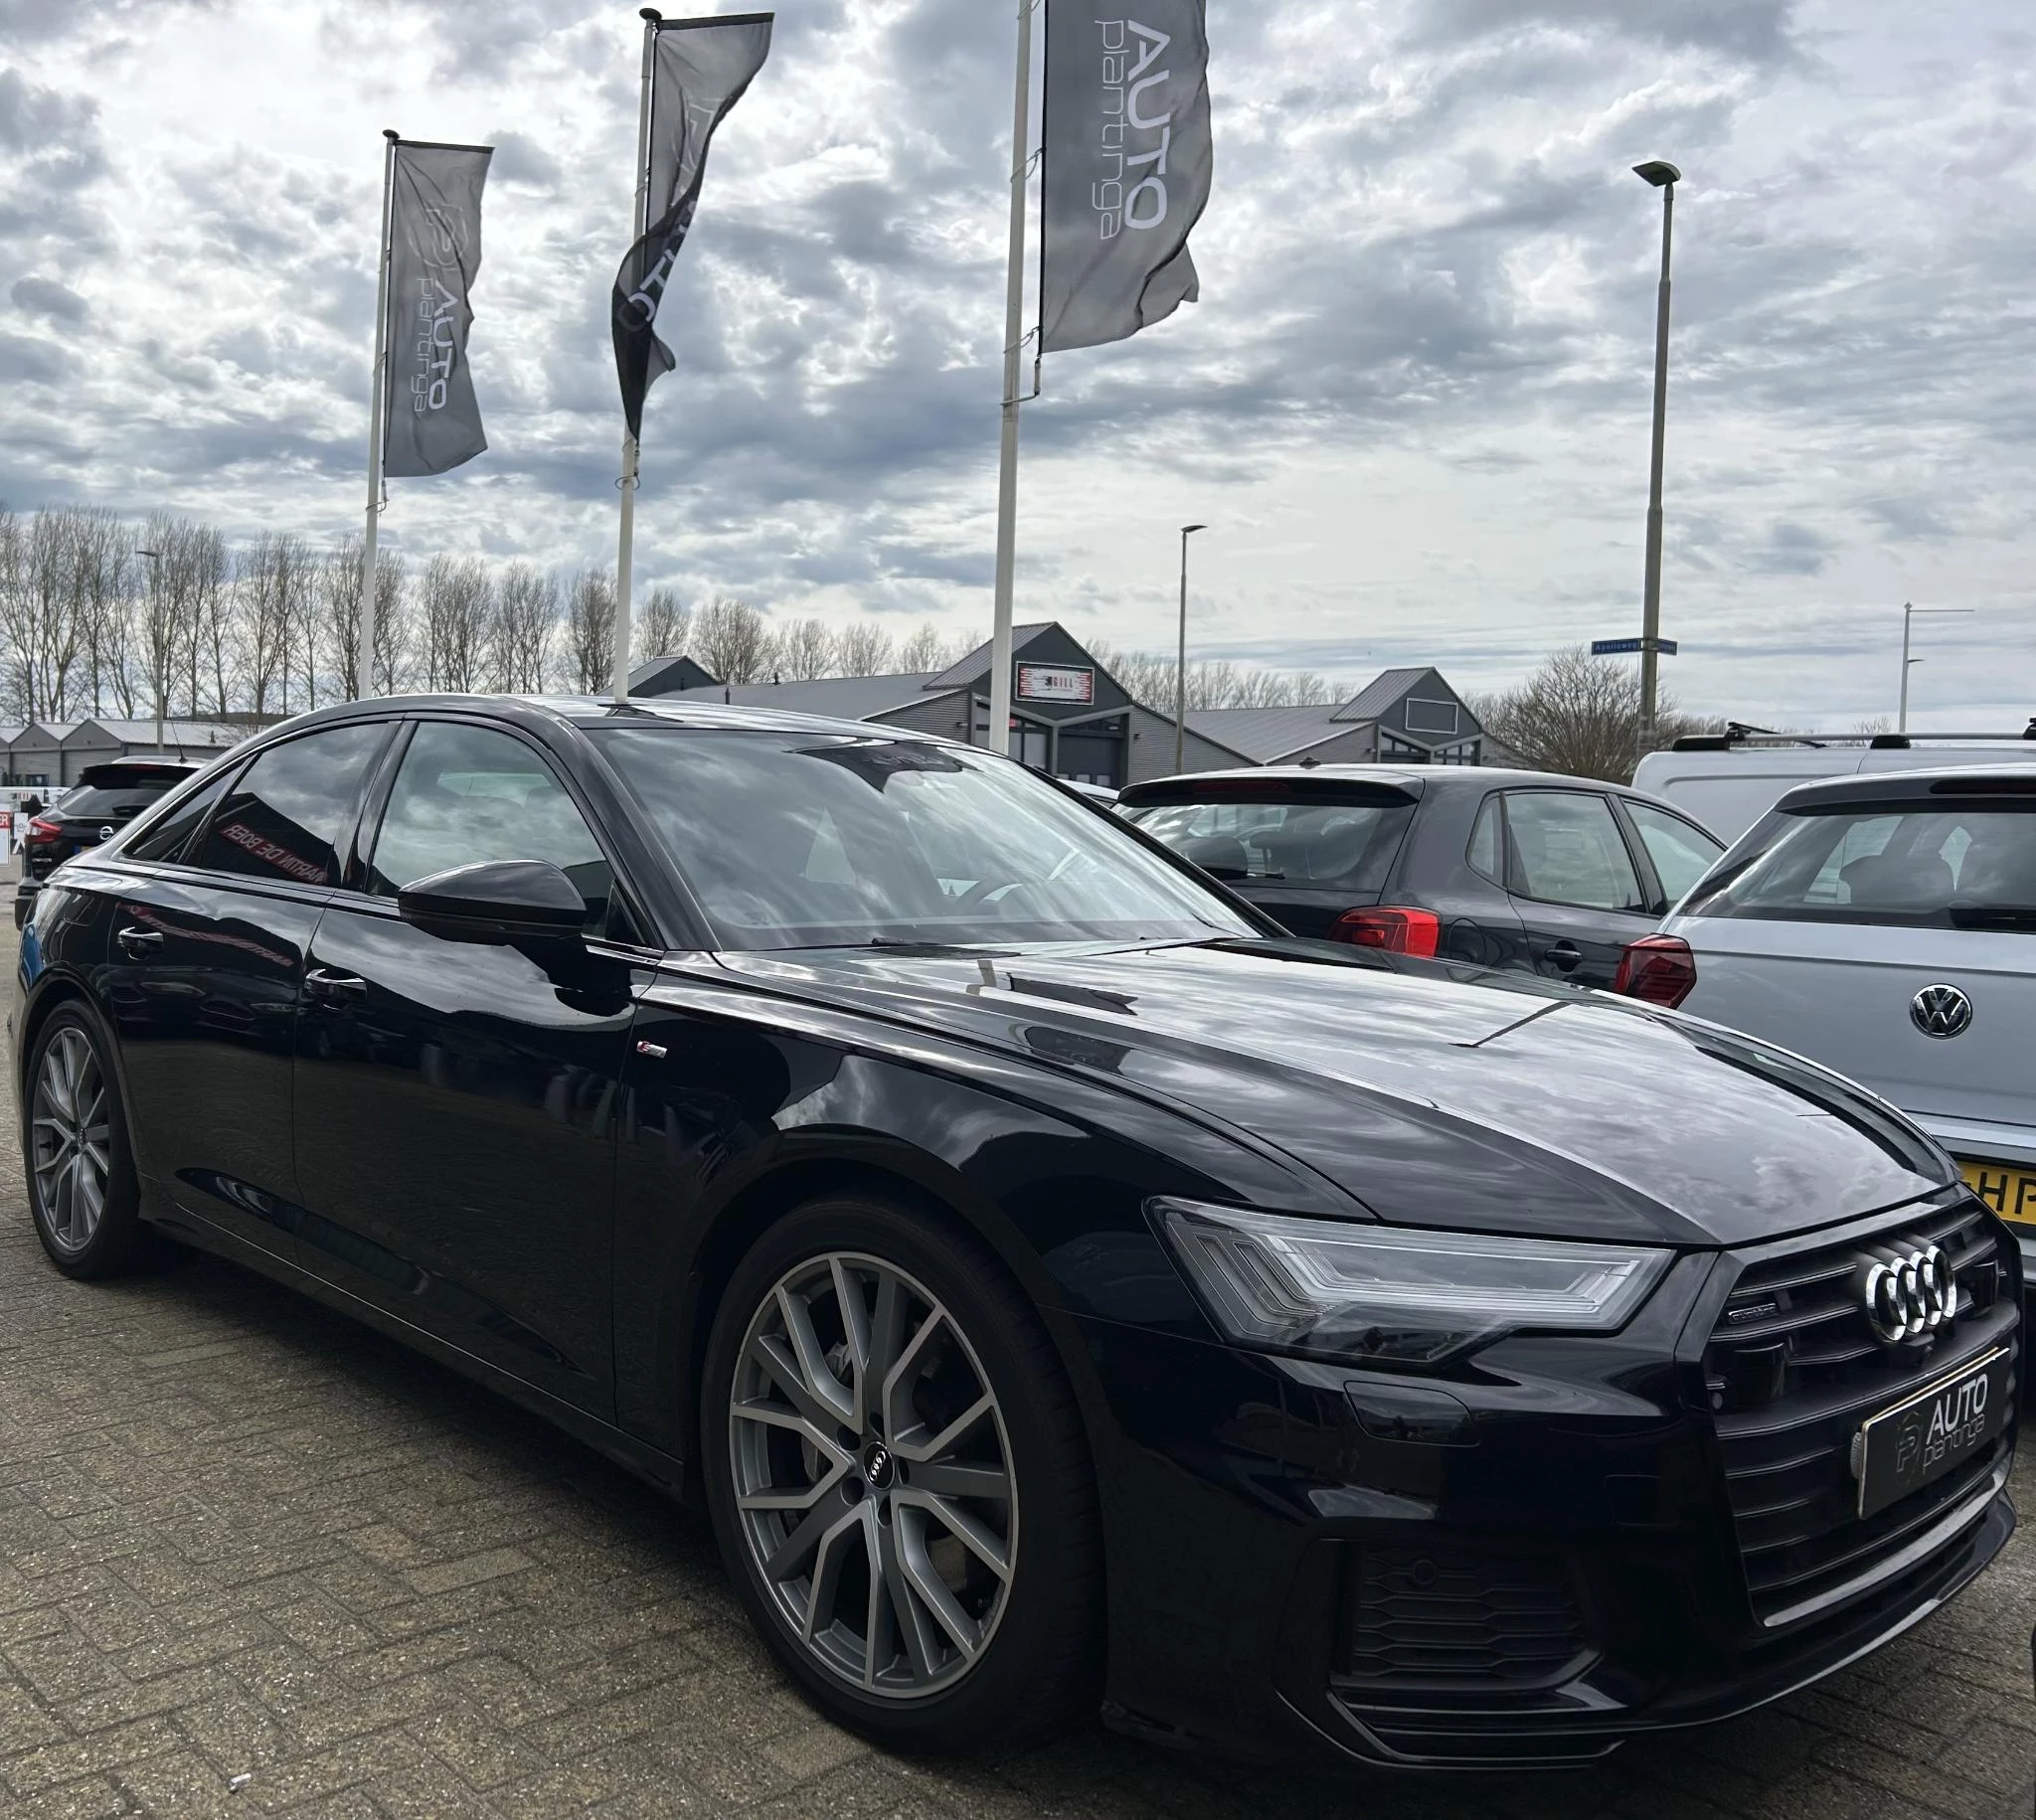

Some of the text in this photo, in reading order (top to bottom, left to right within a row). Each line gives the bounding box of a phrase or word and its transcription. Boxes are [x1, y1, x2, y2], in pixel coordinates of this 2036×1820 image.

[1093, 20, 1129, 240] plantinga
[1125, 19, 1171, 230] AUTO
[428, 279, 458, 410] AUTO
[1926, 1373, 1988, 1445] AUTO
